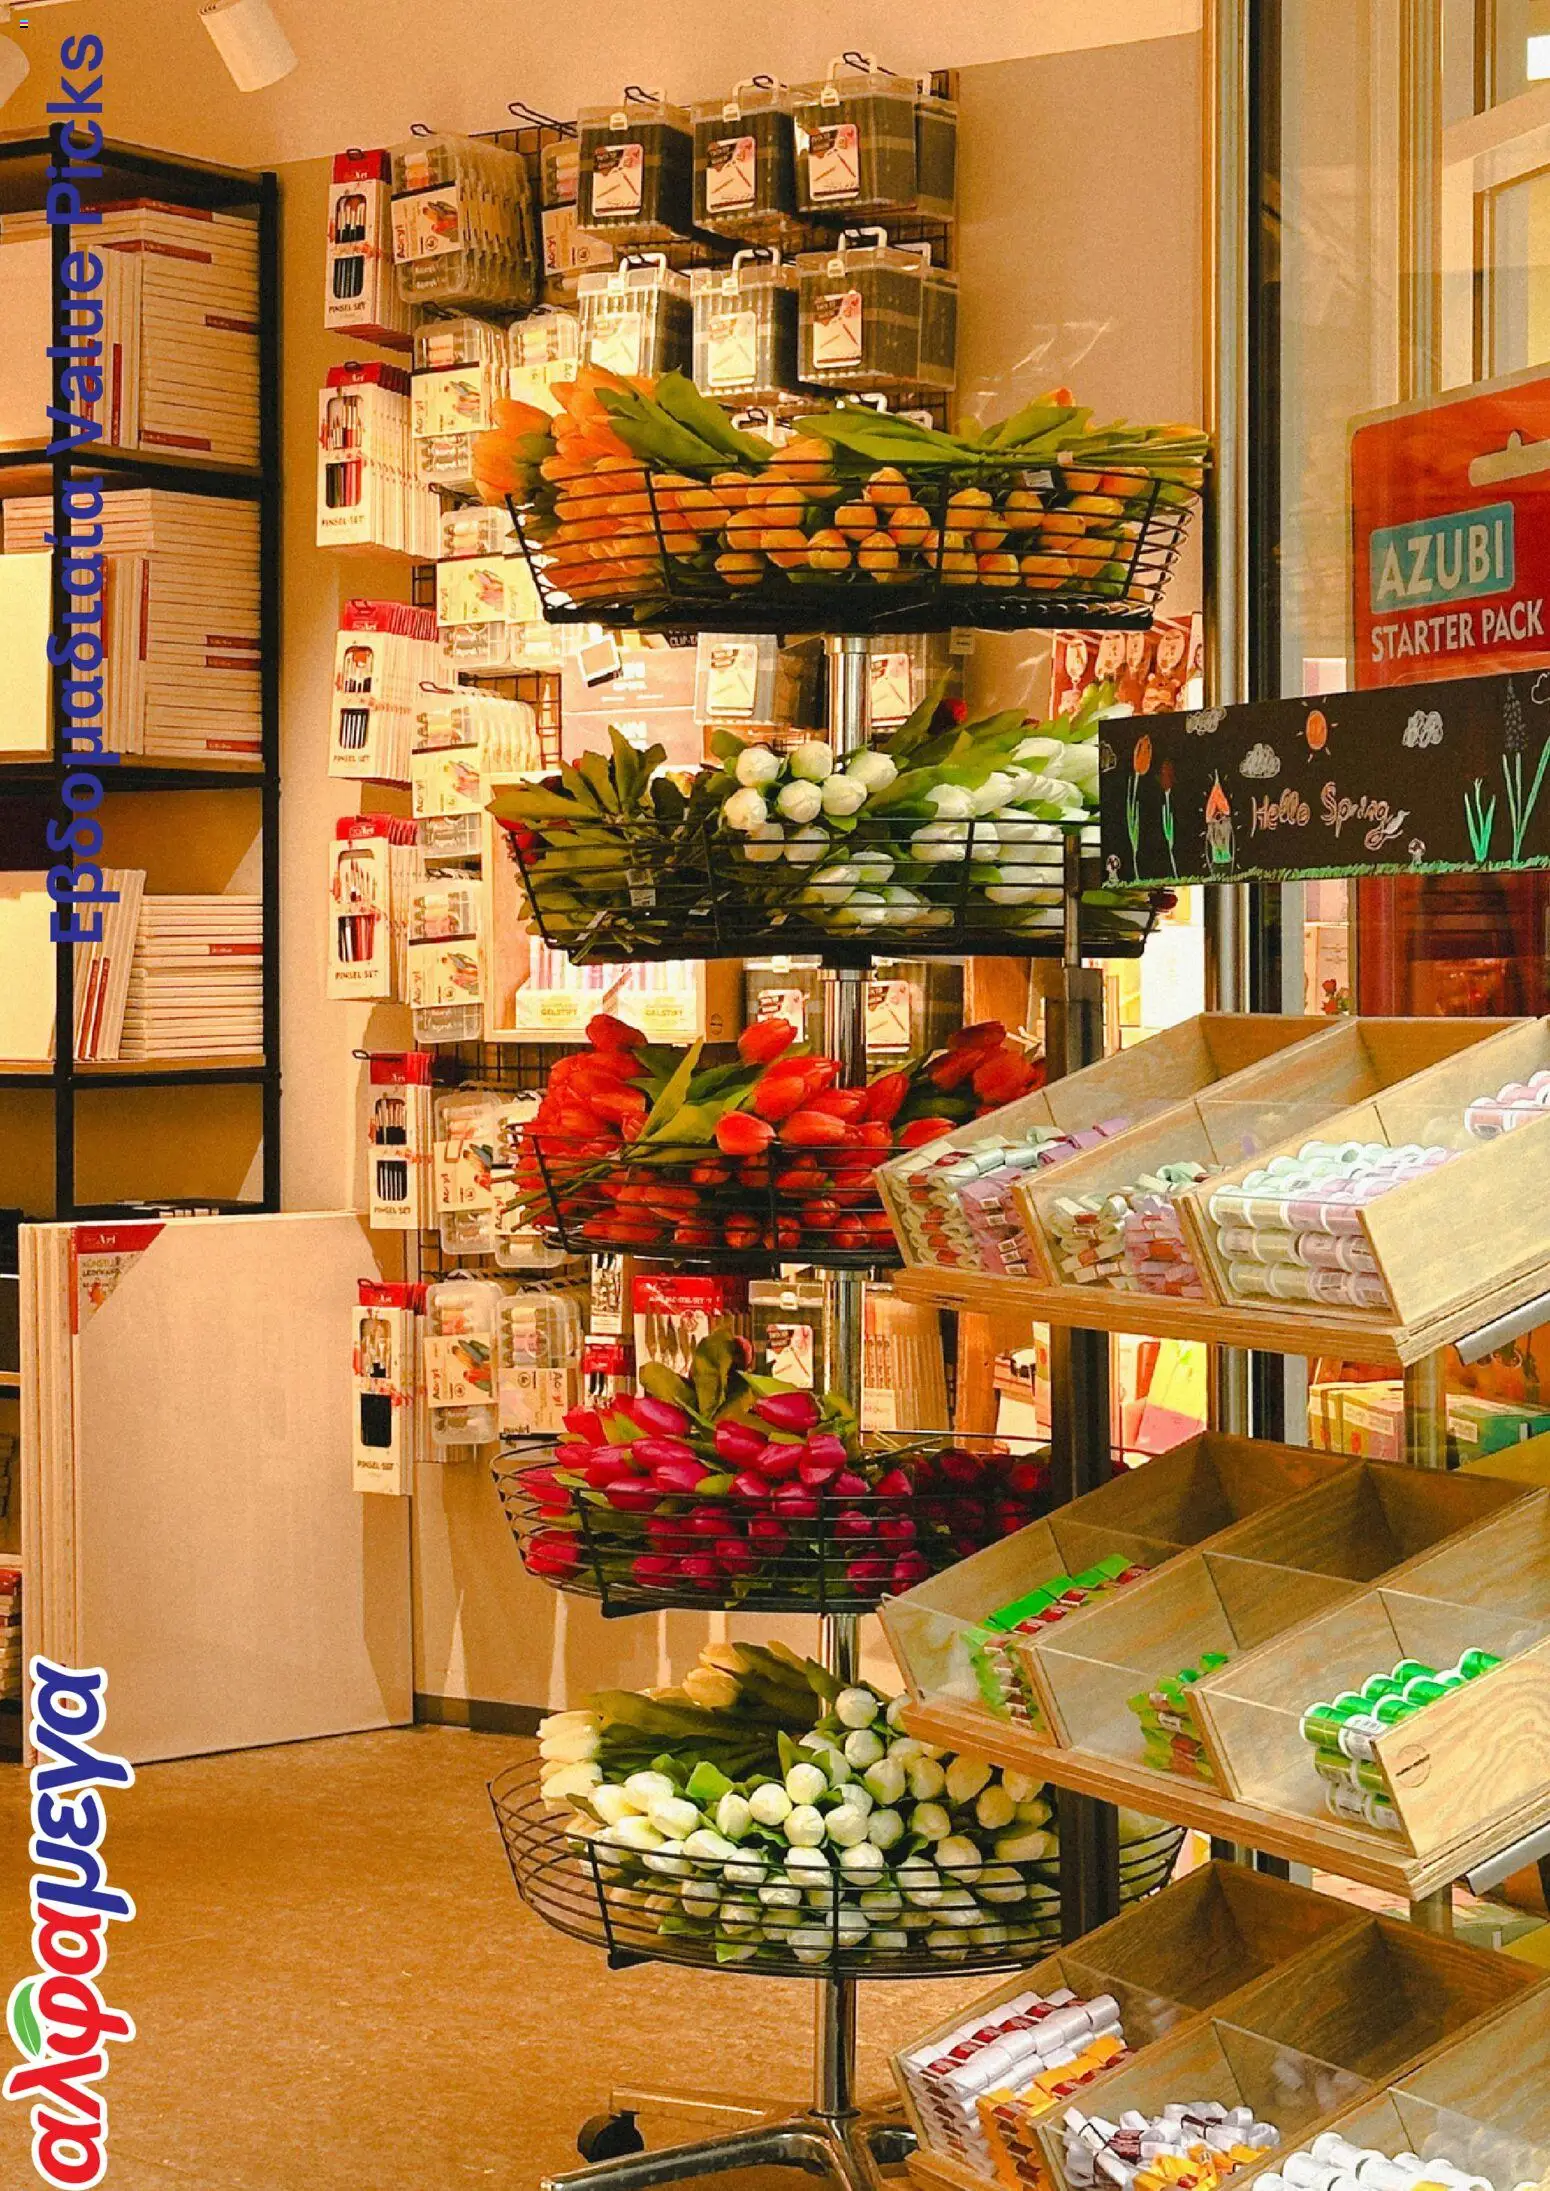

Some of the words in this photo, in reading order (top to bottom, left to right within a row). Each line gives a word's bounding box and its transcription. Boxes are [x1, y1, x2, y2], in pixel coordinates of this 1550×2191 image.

[394, 224, 407, 259] Acryl
[545, 235, 557, 270] Acryl
[414, 400, 425, 435] Acryl
[1375, 519, 1505, 602] AZUBI
[1371, 611, 1476, 663] STARTER
[1481, 598, 1545, 645] PACK
[1250, 787, 1311, 839] Hello
[1320, 781, 1405, 851] Spring
[334, 971, 362, 980] PINSEL
[412, 970, 423, 1005] Acryl
[442, 1172, 453, 1204] Acryl
[430, 1369, 441, 1400] Acryl
[552, 1370, 565, 1407] Acryl
